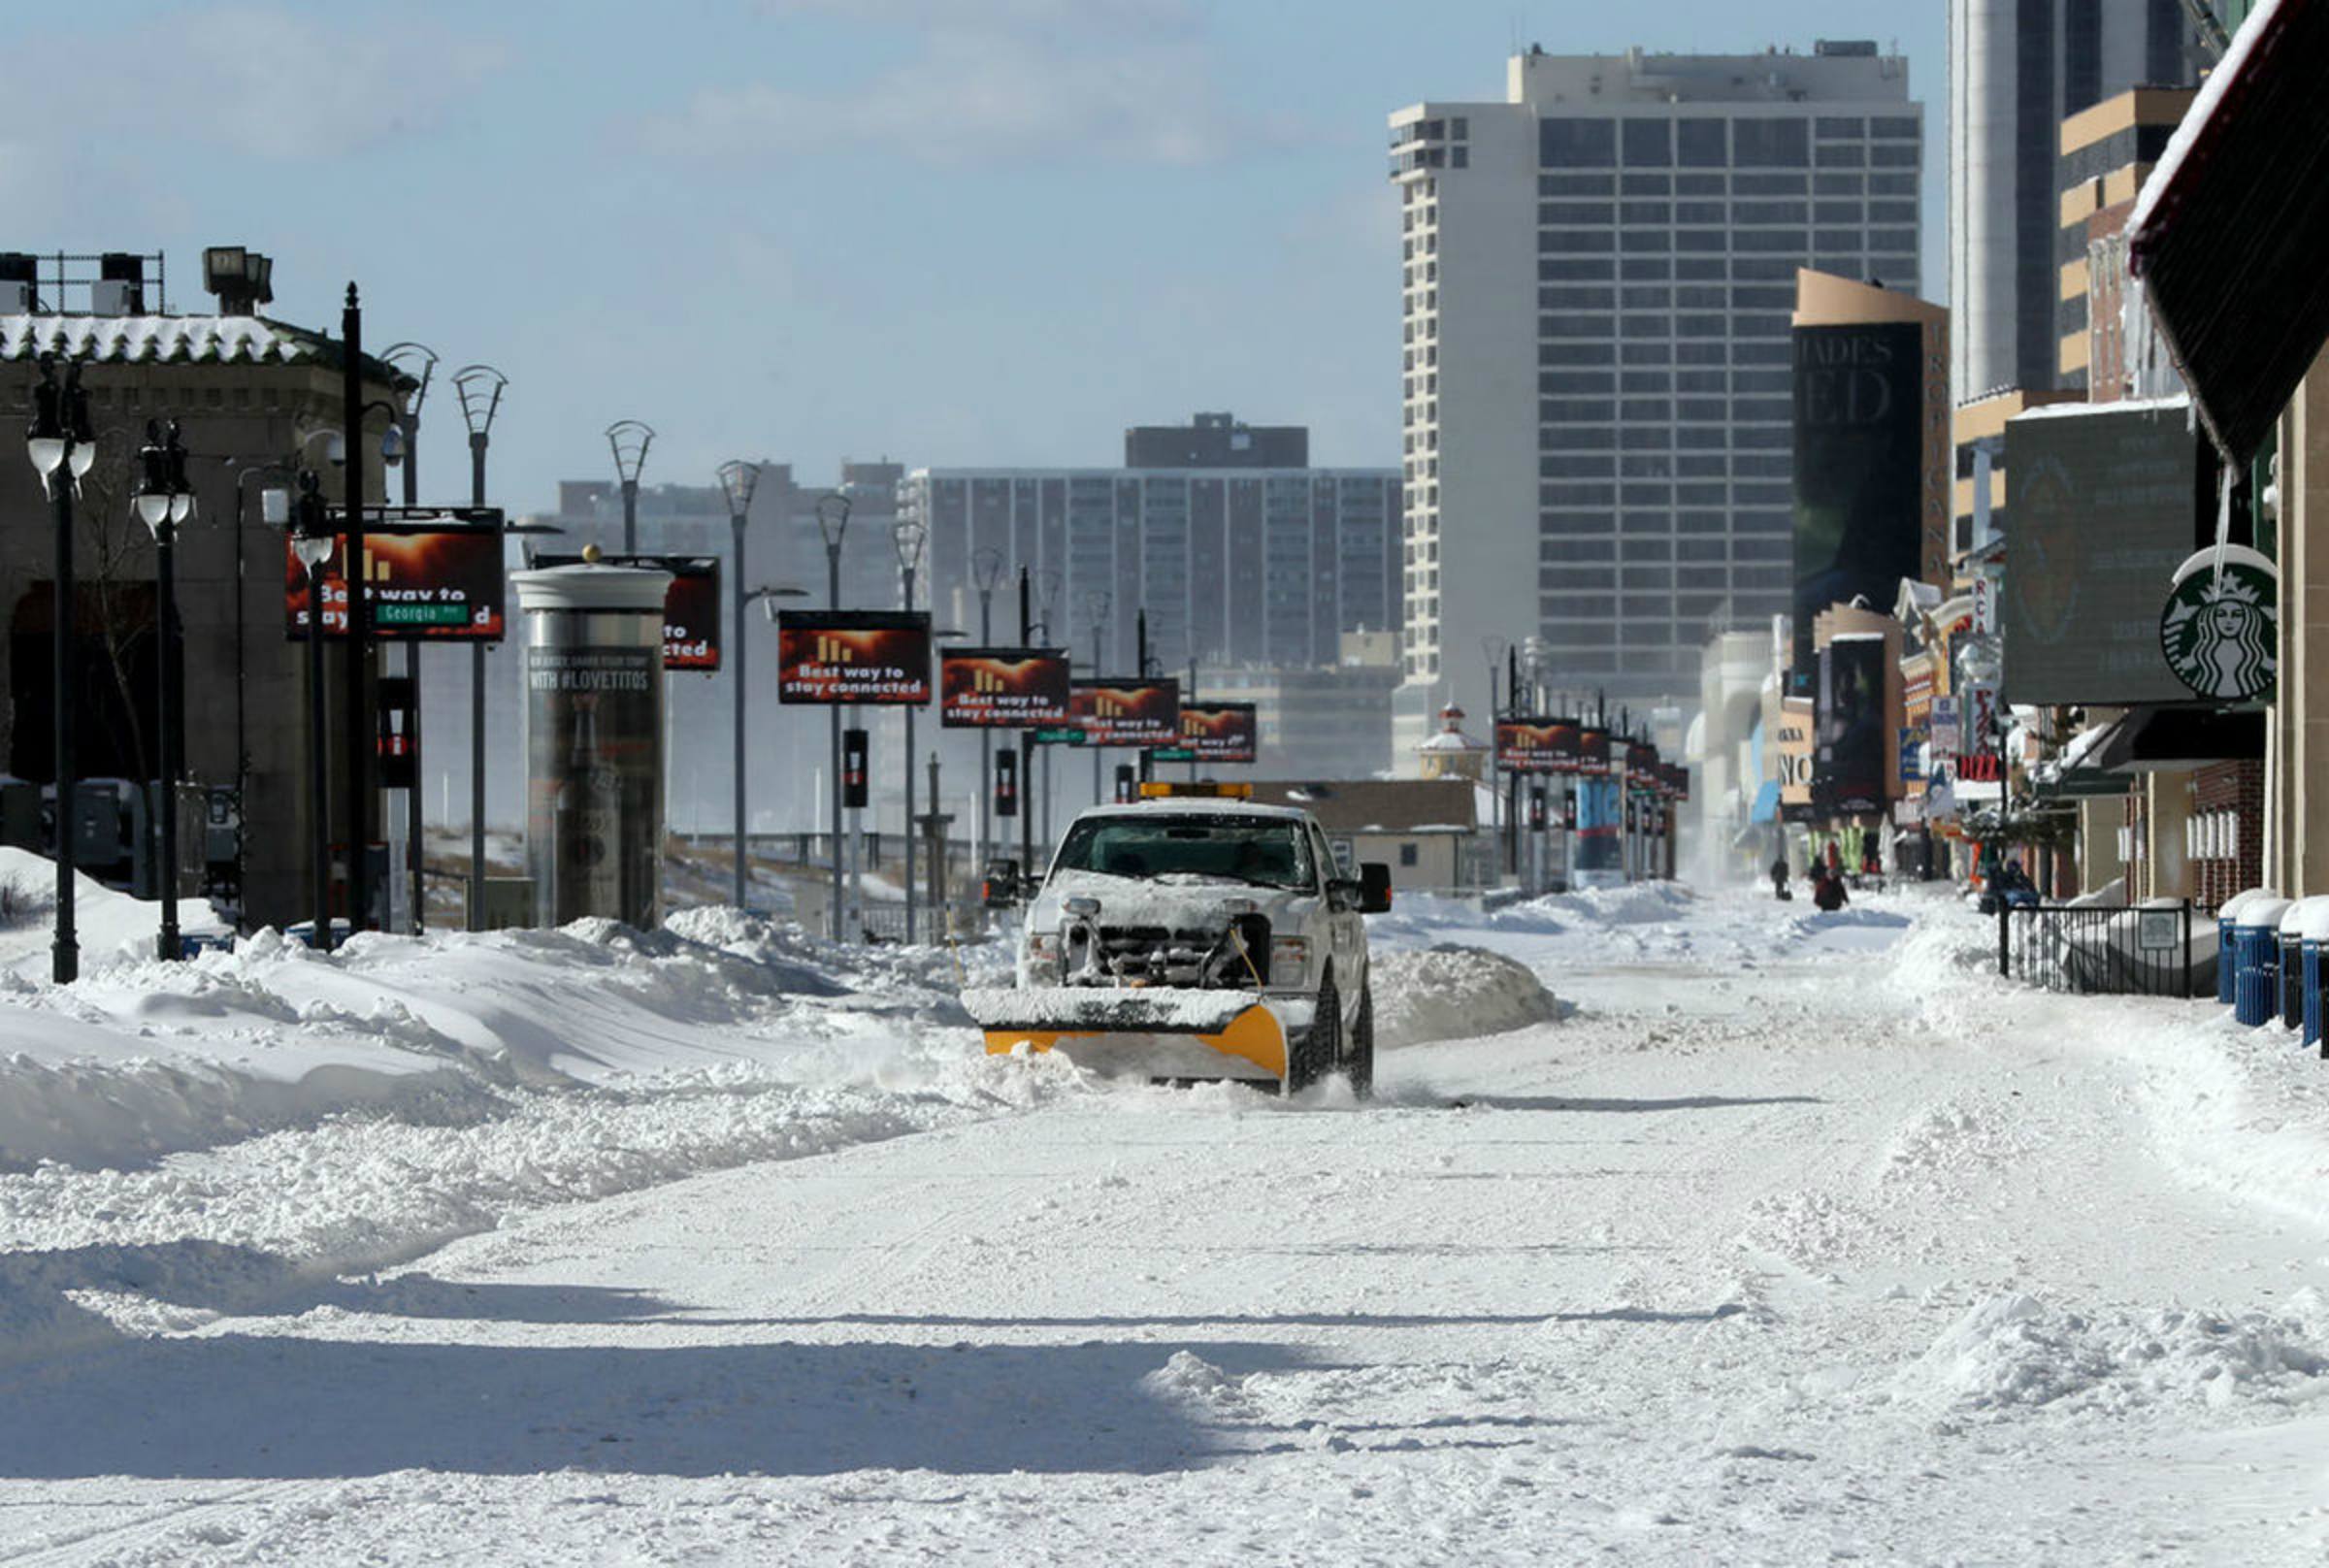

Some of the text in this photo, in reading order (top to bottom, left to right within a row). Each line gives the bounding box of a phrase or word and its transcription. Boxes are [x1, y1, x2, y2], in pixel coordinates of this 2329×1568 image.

[1925, 323, 1947, 579] TROPICANA
[321, 584, 374, 603] Bet
[439, 586, 467, 602] to
[296, 609, 348, 630] say
[385, 604, 436, 621] Georgia
[663, 625, 687, 638] to
[799, 665, 904, 681] Best way to
[786, 679, 921, 696] stay connected
[958, 692, 1049, 708] Best way to
[947, 705, 1065, 721] stay connected
[1115, 720, 1143, 731] way
[1146, 718, 1161, 729] to
